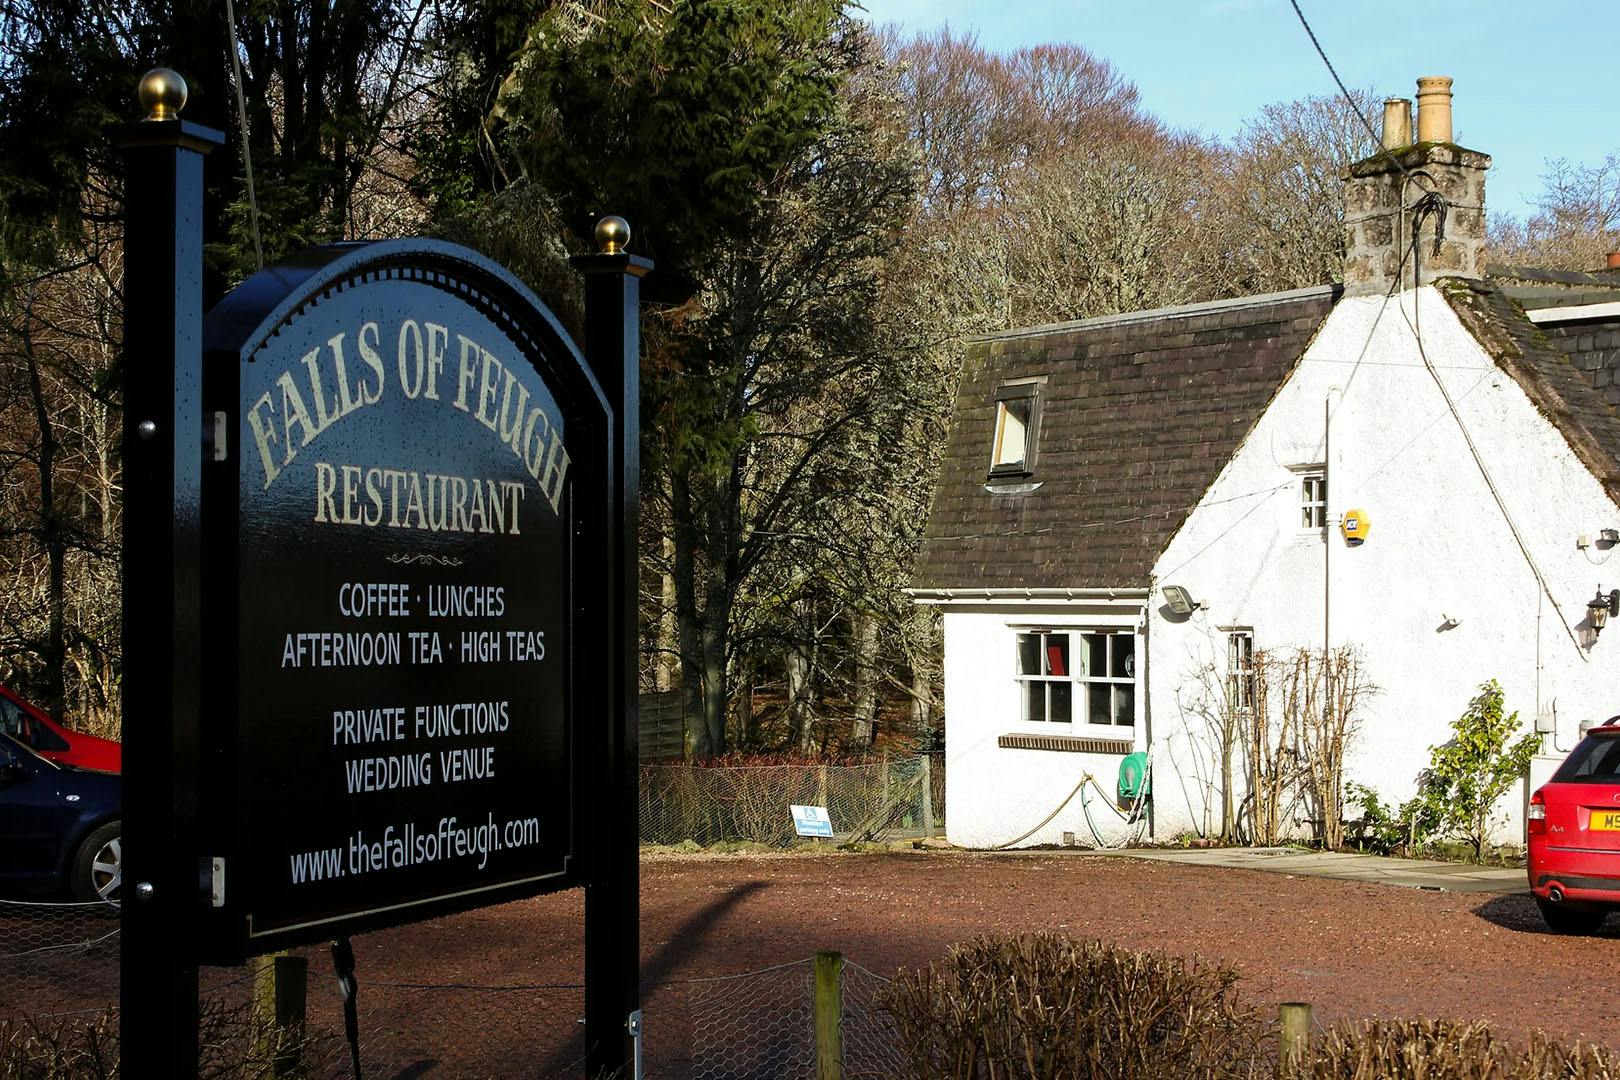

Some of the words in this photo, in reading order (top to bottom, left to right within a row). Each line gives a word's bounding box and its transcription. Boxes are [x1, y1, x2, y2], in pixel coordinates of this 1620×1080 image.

[248, 322, 385, 490] FALLS
[398, 319, 448, 401] OF
[453, 334, 572, 516] FEUGH
[314, 462, 525, 535] RESTAURANT
[339, 583, 410, 618] COFFEE
[428, 585, 505, 617] LUNCHES
[281, 632, 400, 668] AFTERNOON
[408, 632, 443, 664] TEA
[461, 631, 500, 663] HIGH
[506, 631, 545, 662] TEAS
[333, 708, 405, 745] PRIVATE
[415, 701, 509, 739] FUNCTIONS
[345, 752, 431, 793] WEDDING
[440, 746, 495, 783] VENUE
